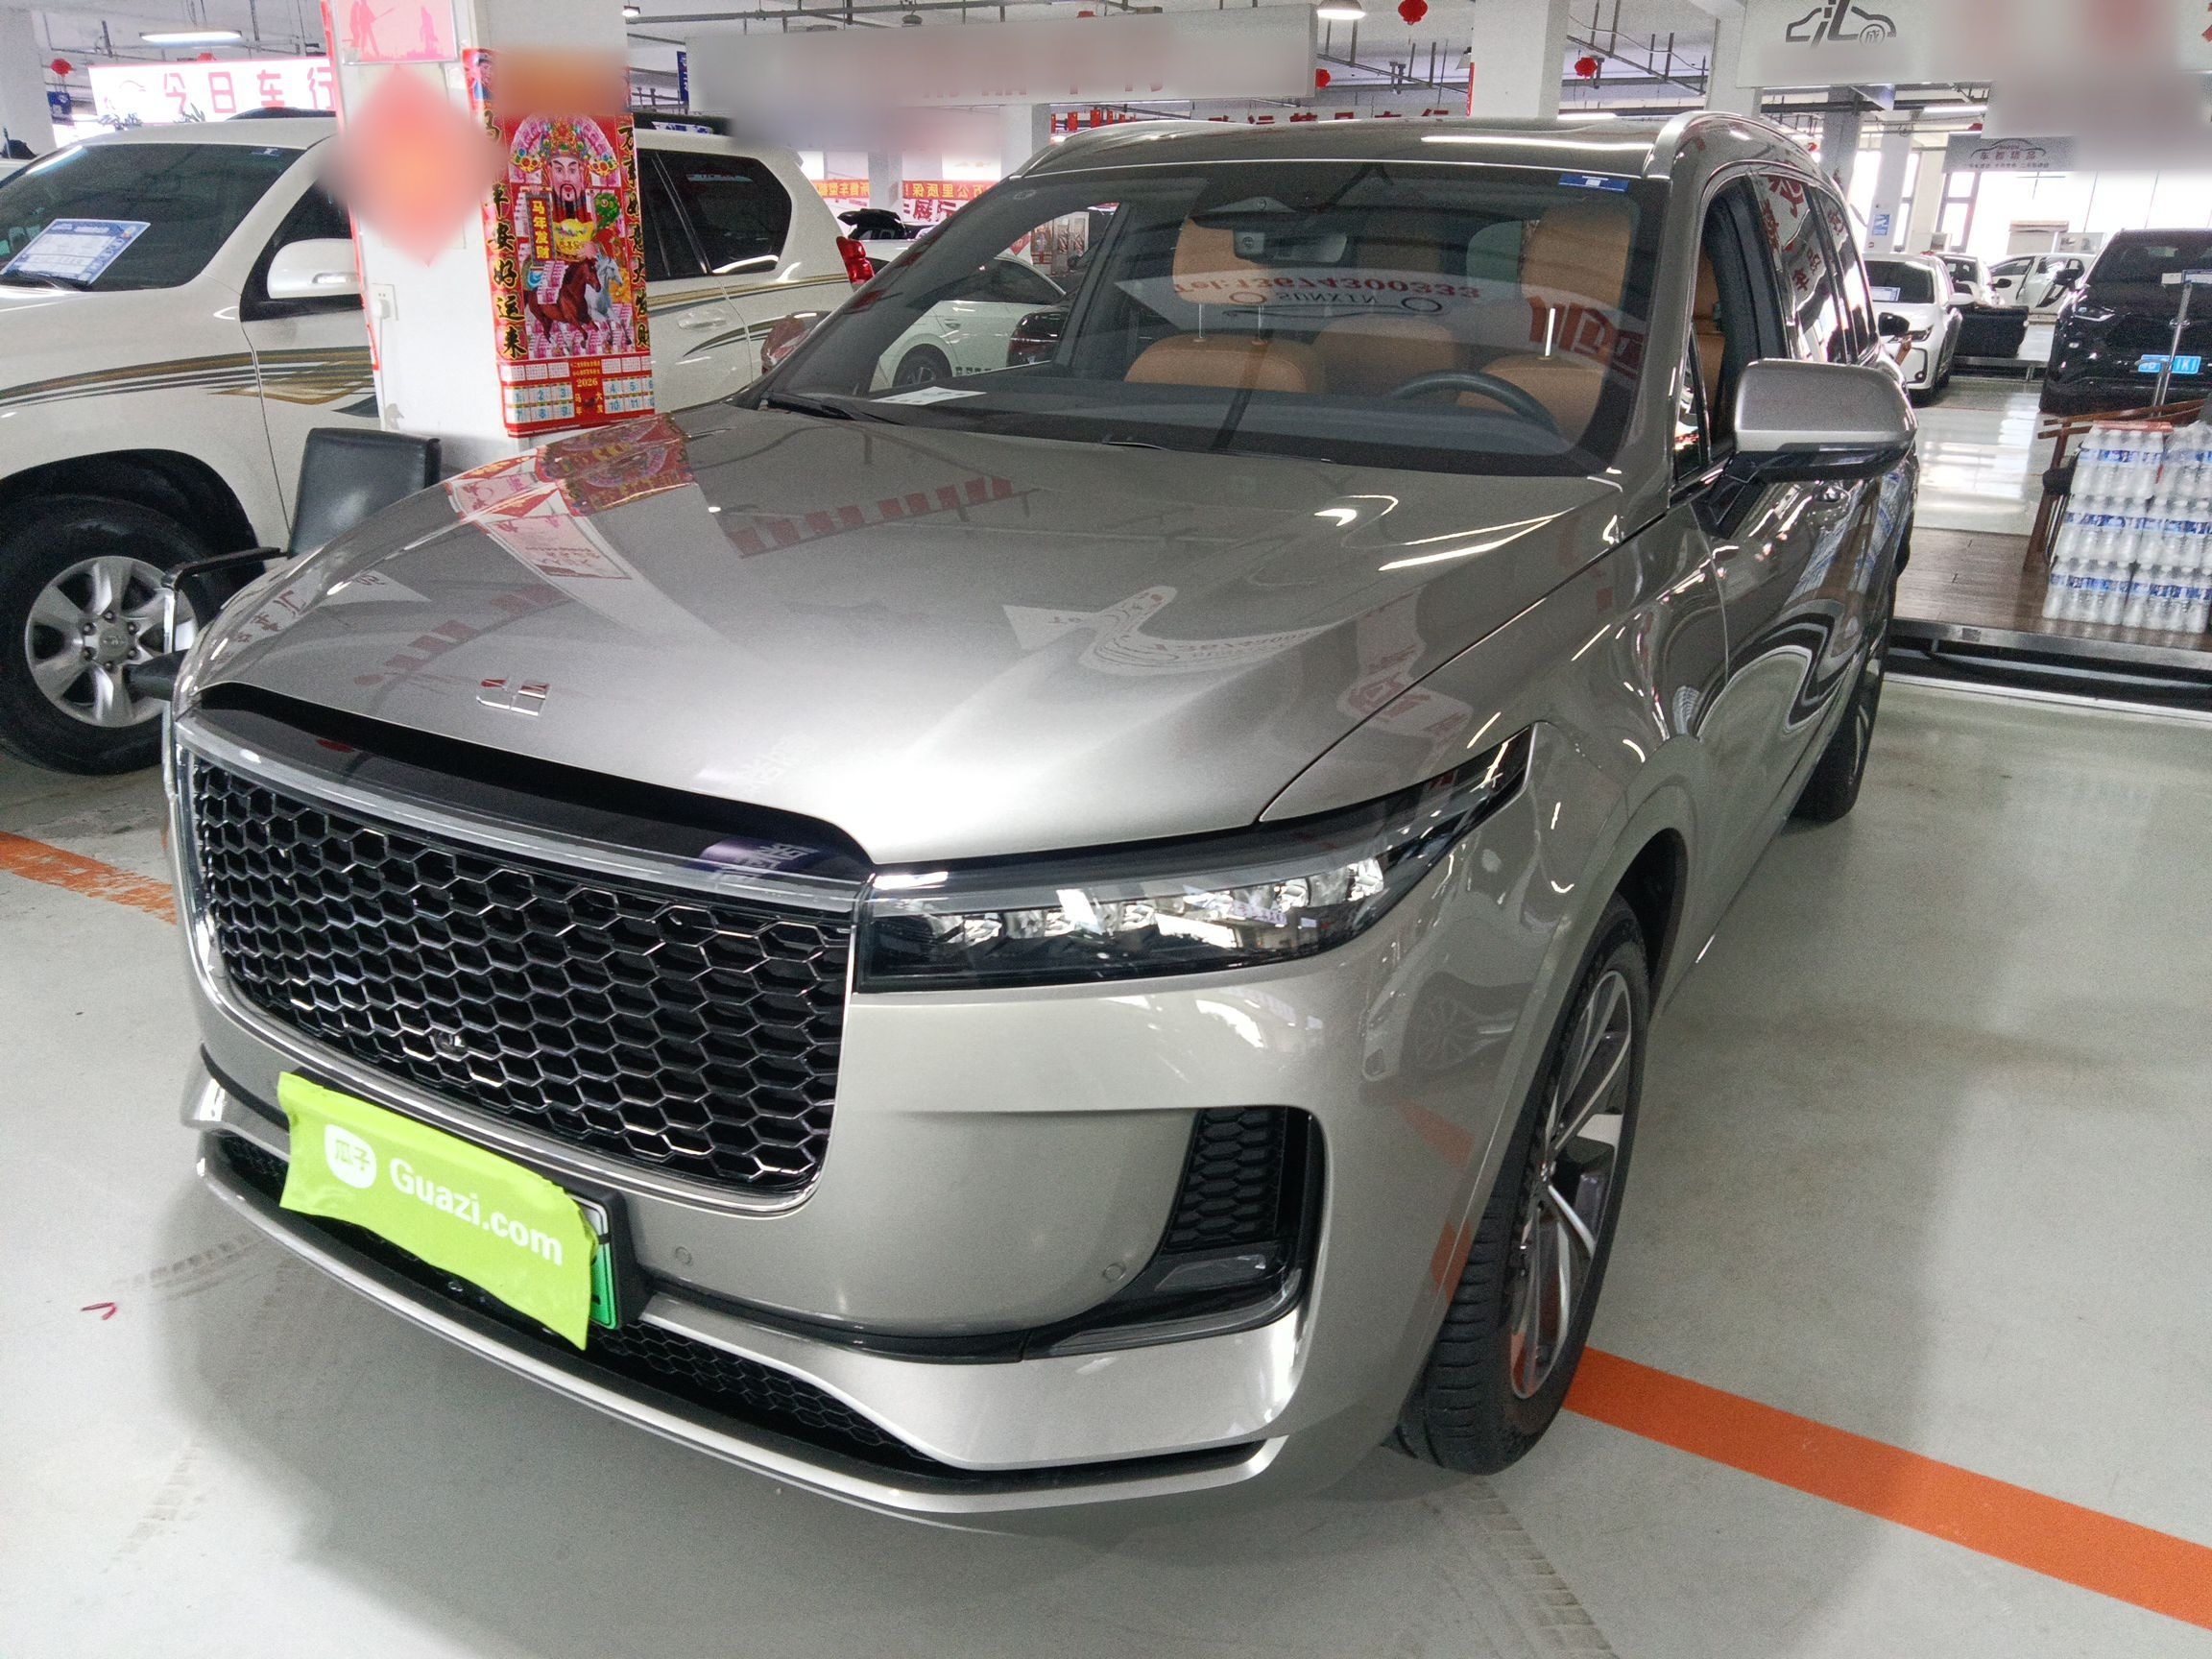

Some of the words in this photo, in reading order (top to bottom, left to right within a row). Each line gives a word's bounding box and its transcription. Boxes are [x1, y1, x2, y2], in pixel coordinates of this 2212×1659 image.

[163, 66, 335, 114] 今日车行
[531, 200, 550, 259] 马年发财
[576, 378, 598, 387] 2026
[335, 1138, 372, 1172] 瓜子
[389, 1157, 564, 1267] Guazi.com
